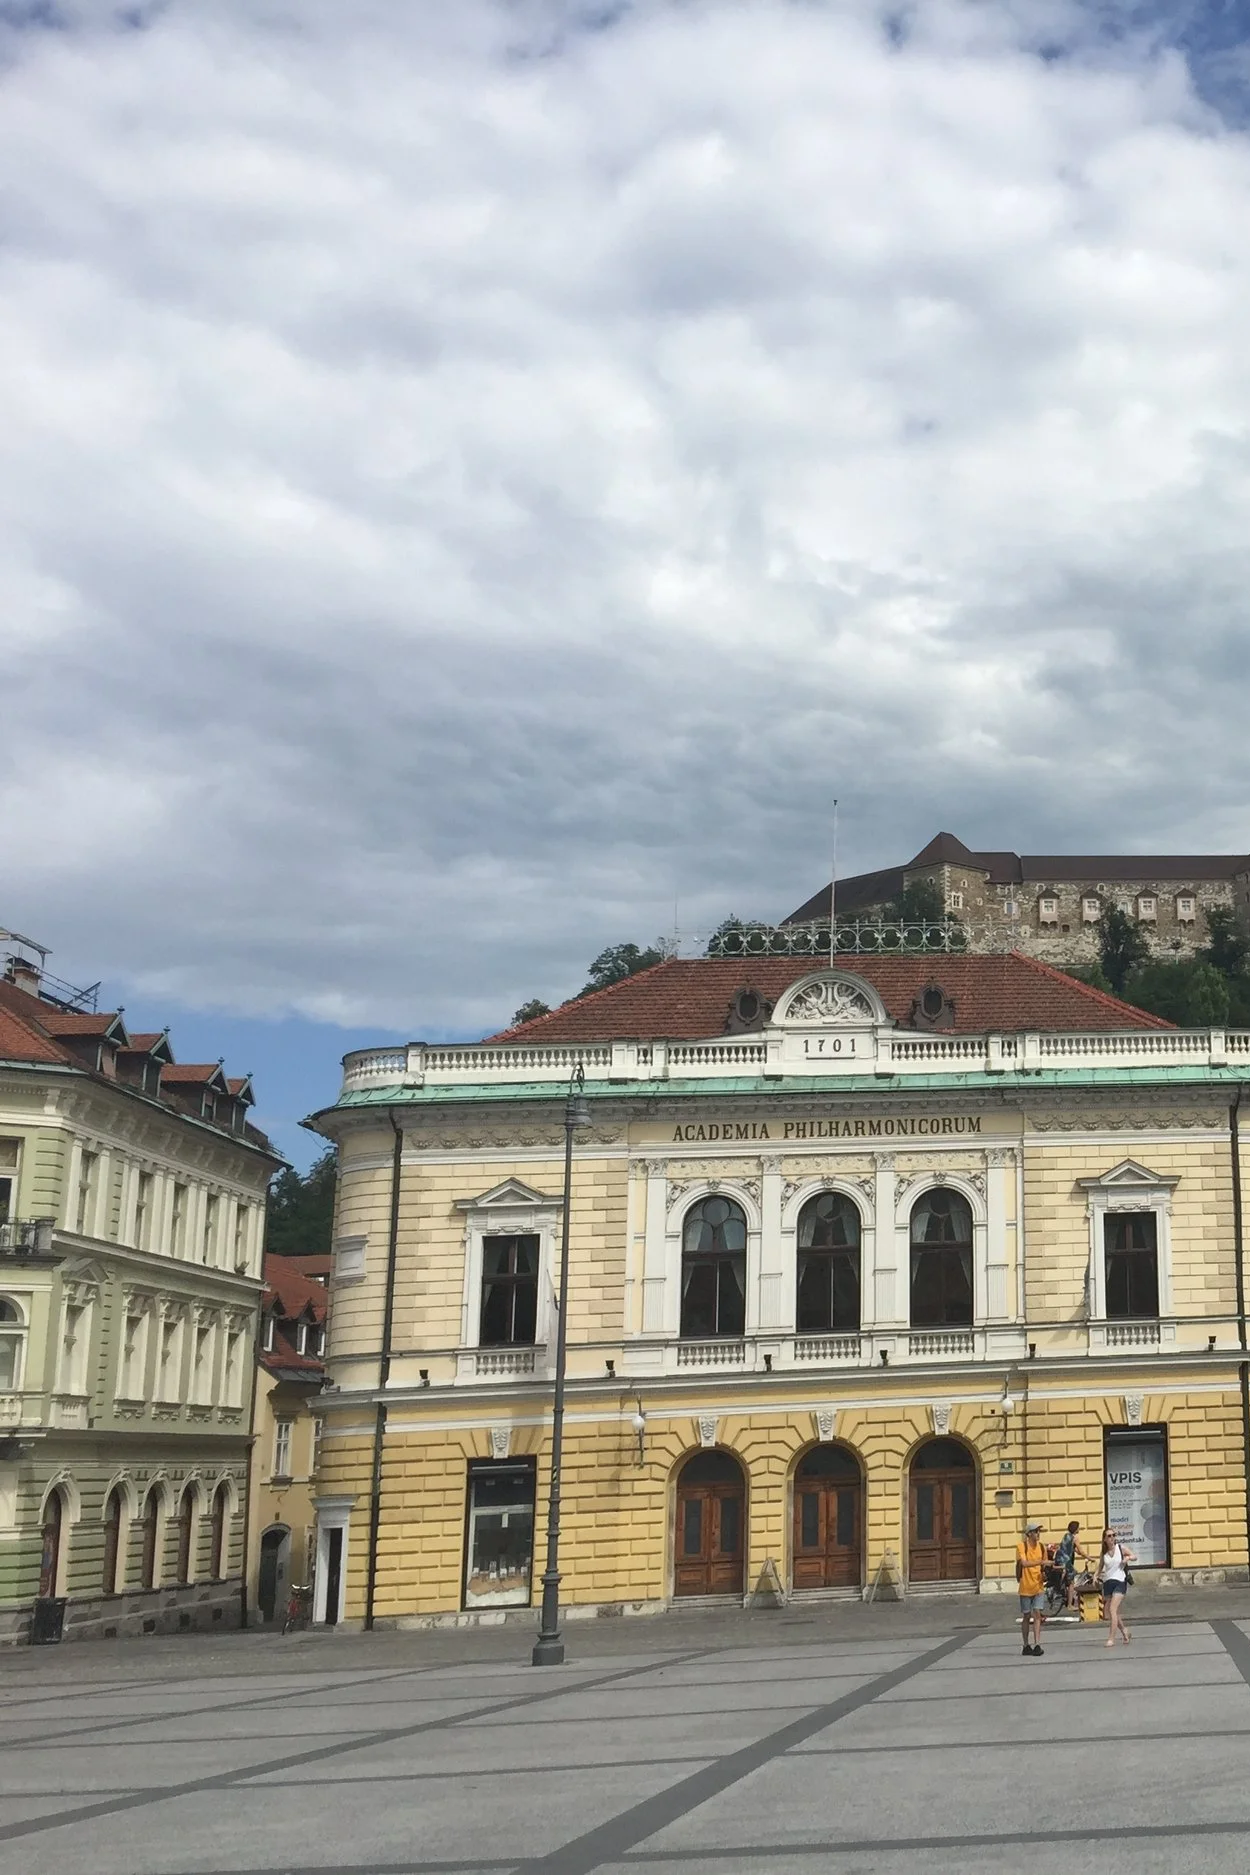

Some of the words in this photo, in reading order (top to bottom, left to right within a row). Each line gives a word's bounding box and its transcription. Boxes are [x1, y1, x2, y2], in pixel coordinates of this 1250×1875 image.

[803, 1038, 856, 1053] 1701
[673, 1122, 770, 1141] ACADEMIA
[783, 1116, 982, 1138] PHILHARMONICORUM
[1109, 1472, 1142, 1484] VPIS
